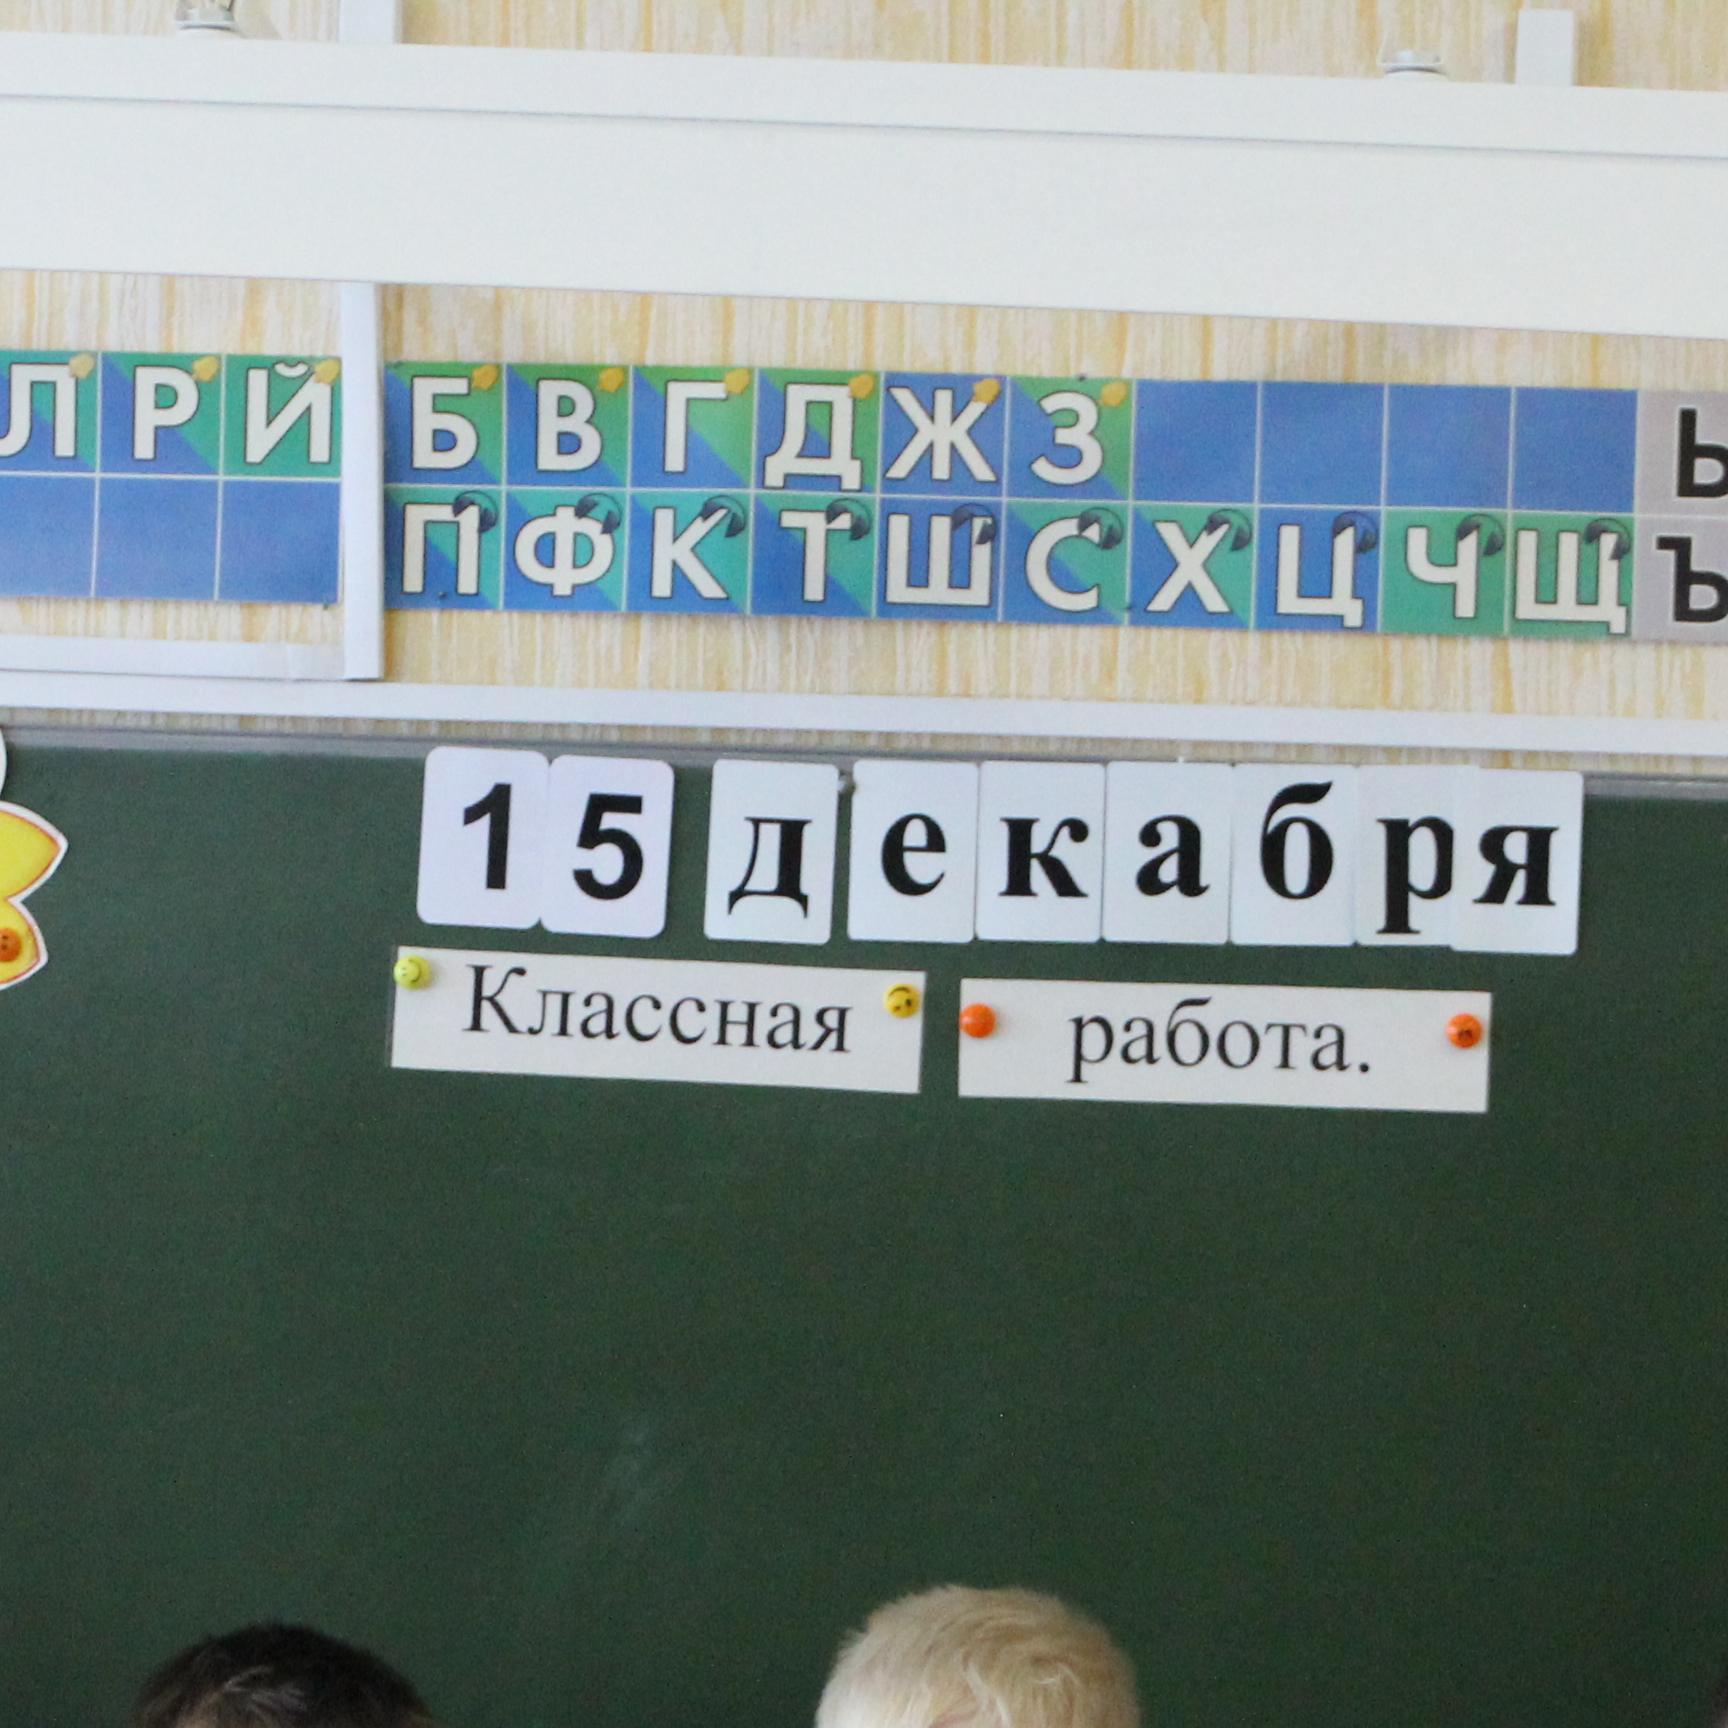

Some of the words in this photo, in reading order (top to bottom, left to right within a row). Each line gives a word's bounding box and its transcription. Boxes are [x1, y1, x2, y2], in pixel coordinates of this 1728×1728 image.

[727, 780, 1560, 935] декабря
[462, 964, 851, 1055] Классная
[1066, 1004, 1374, 1083] работа.
